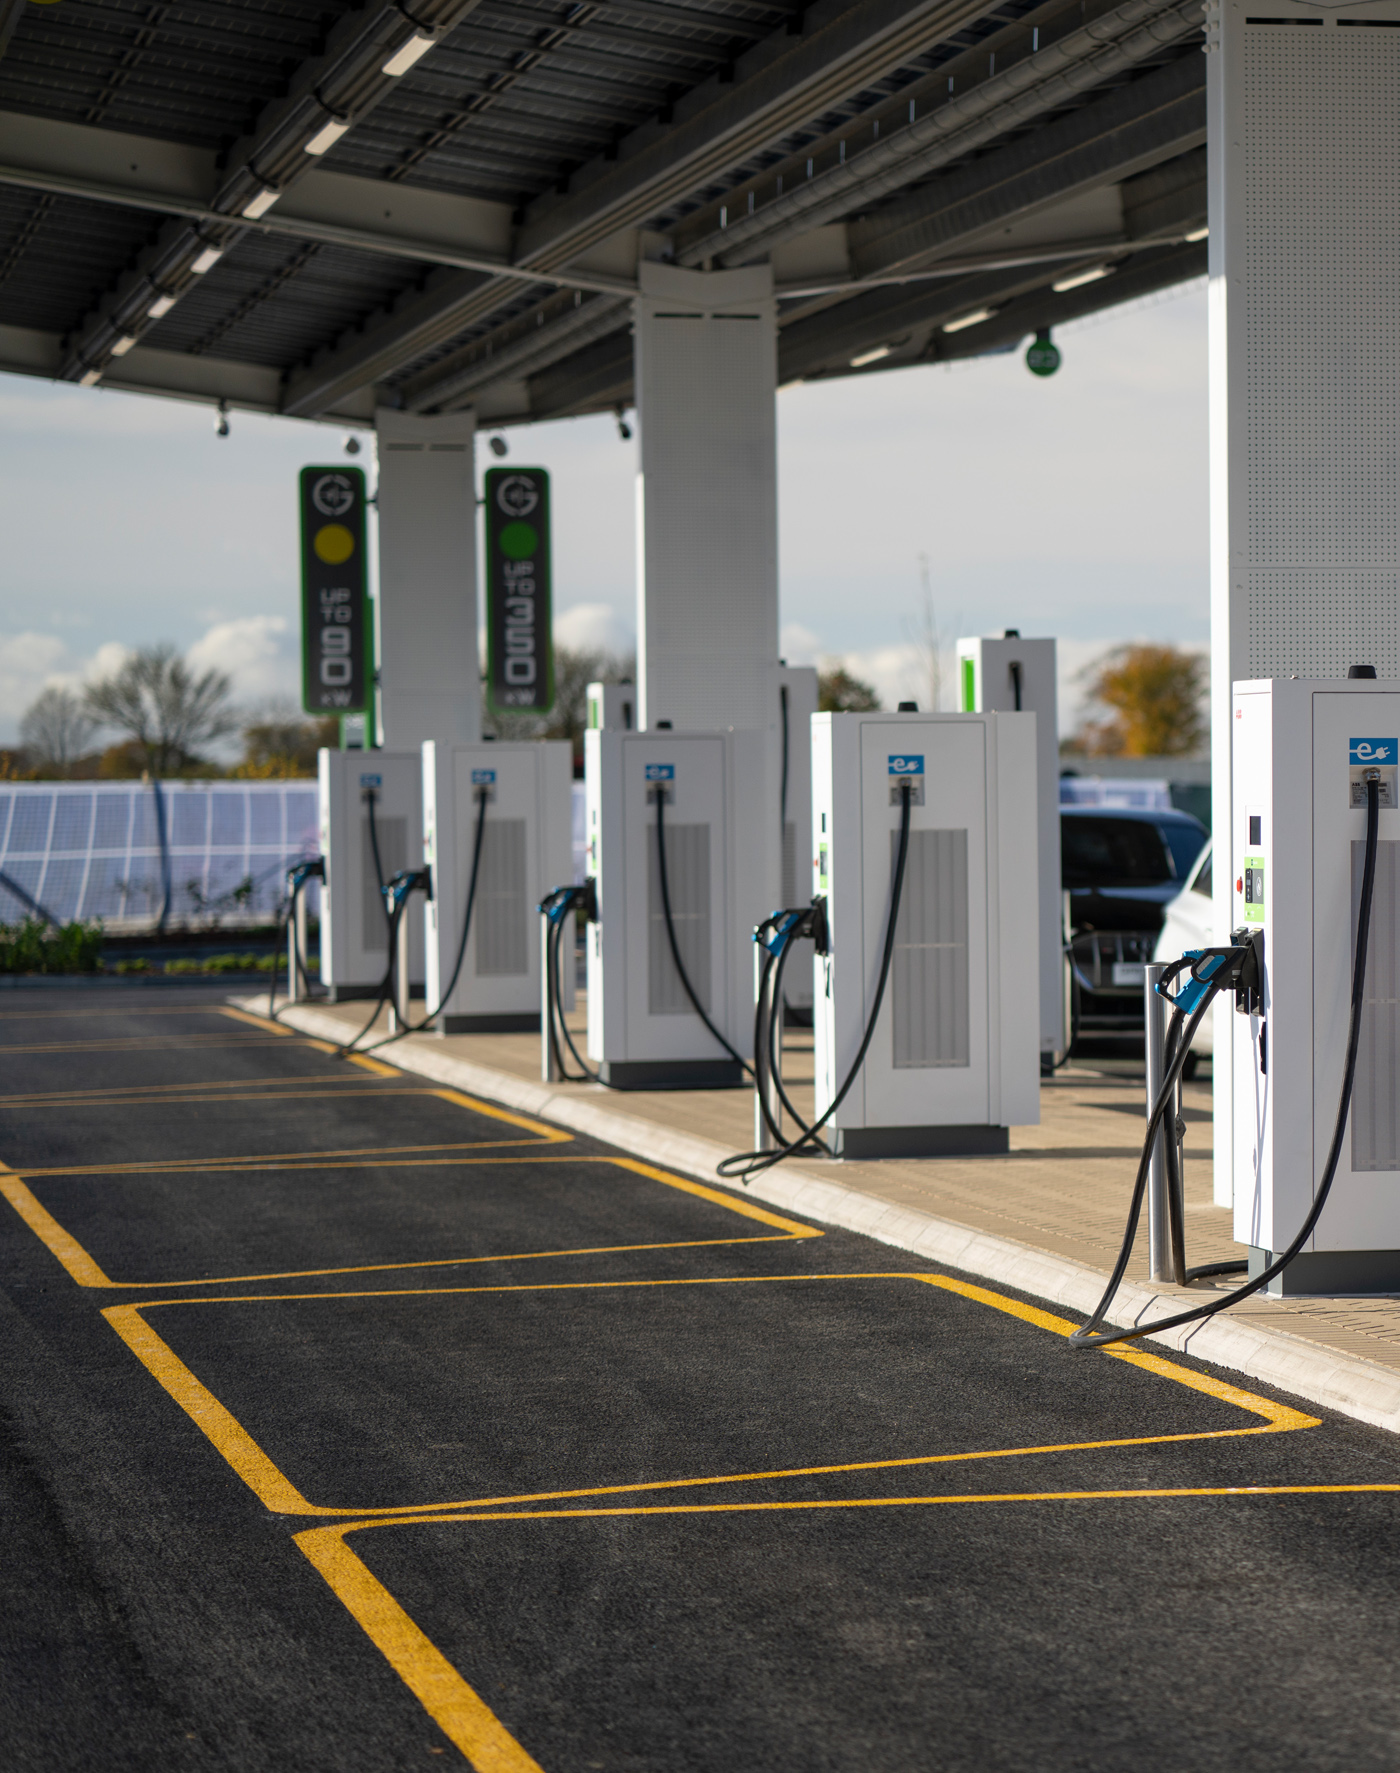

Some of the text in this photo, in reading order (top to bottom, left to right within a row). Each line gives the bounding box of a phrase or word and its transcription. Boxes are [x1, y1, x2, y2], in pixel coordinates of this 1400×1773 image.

[504, 560, 536, 577] UP
[320, 587, 351, 604] UP
[503, 579, 536, 596] TO
[320, 605, 352, 623] TO
[504, 597, 537, 686] 350
[320, 625, 353, 686] 90
